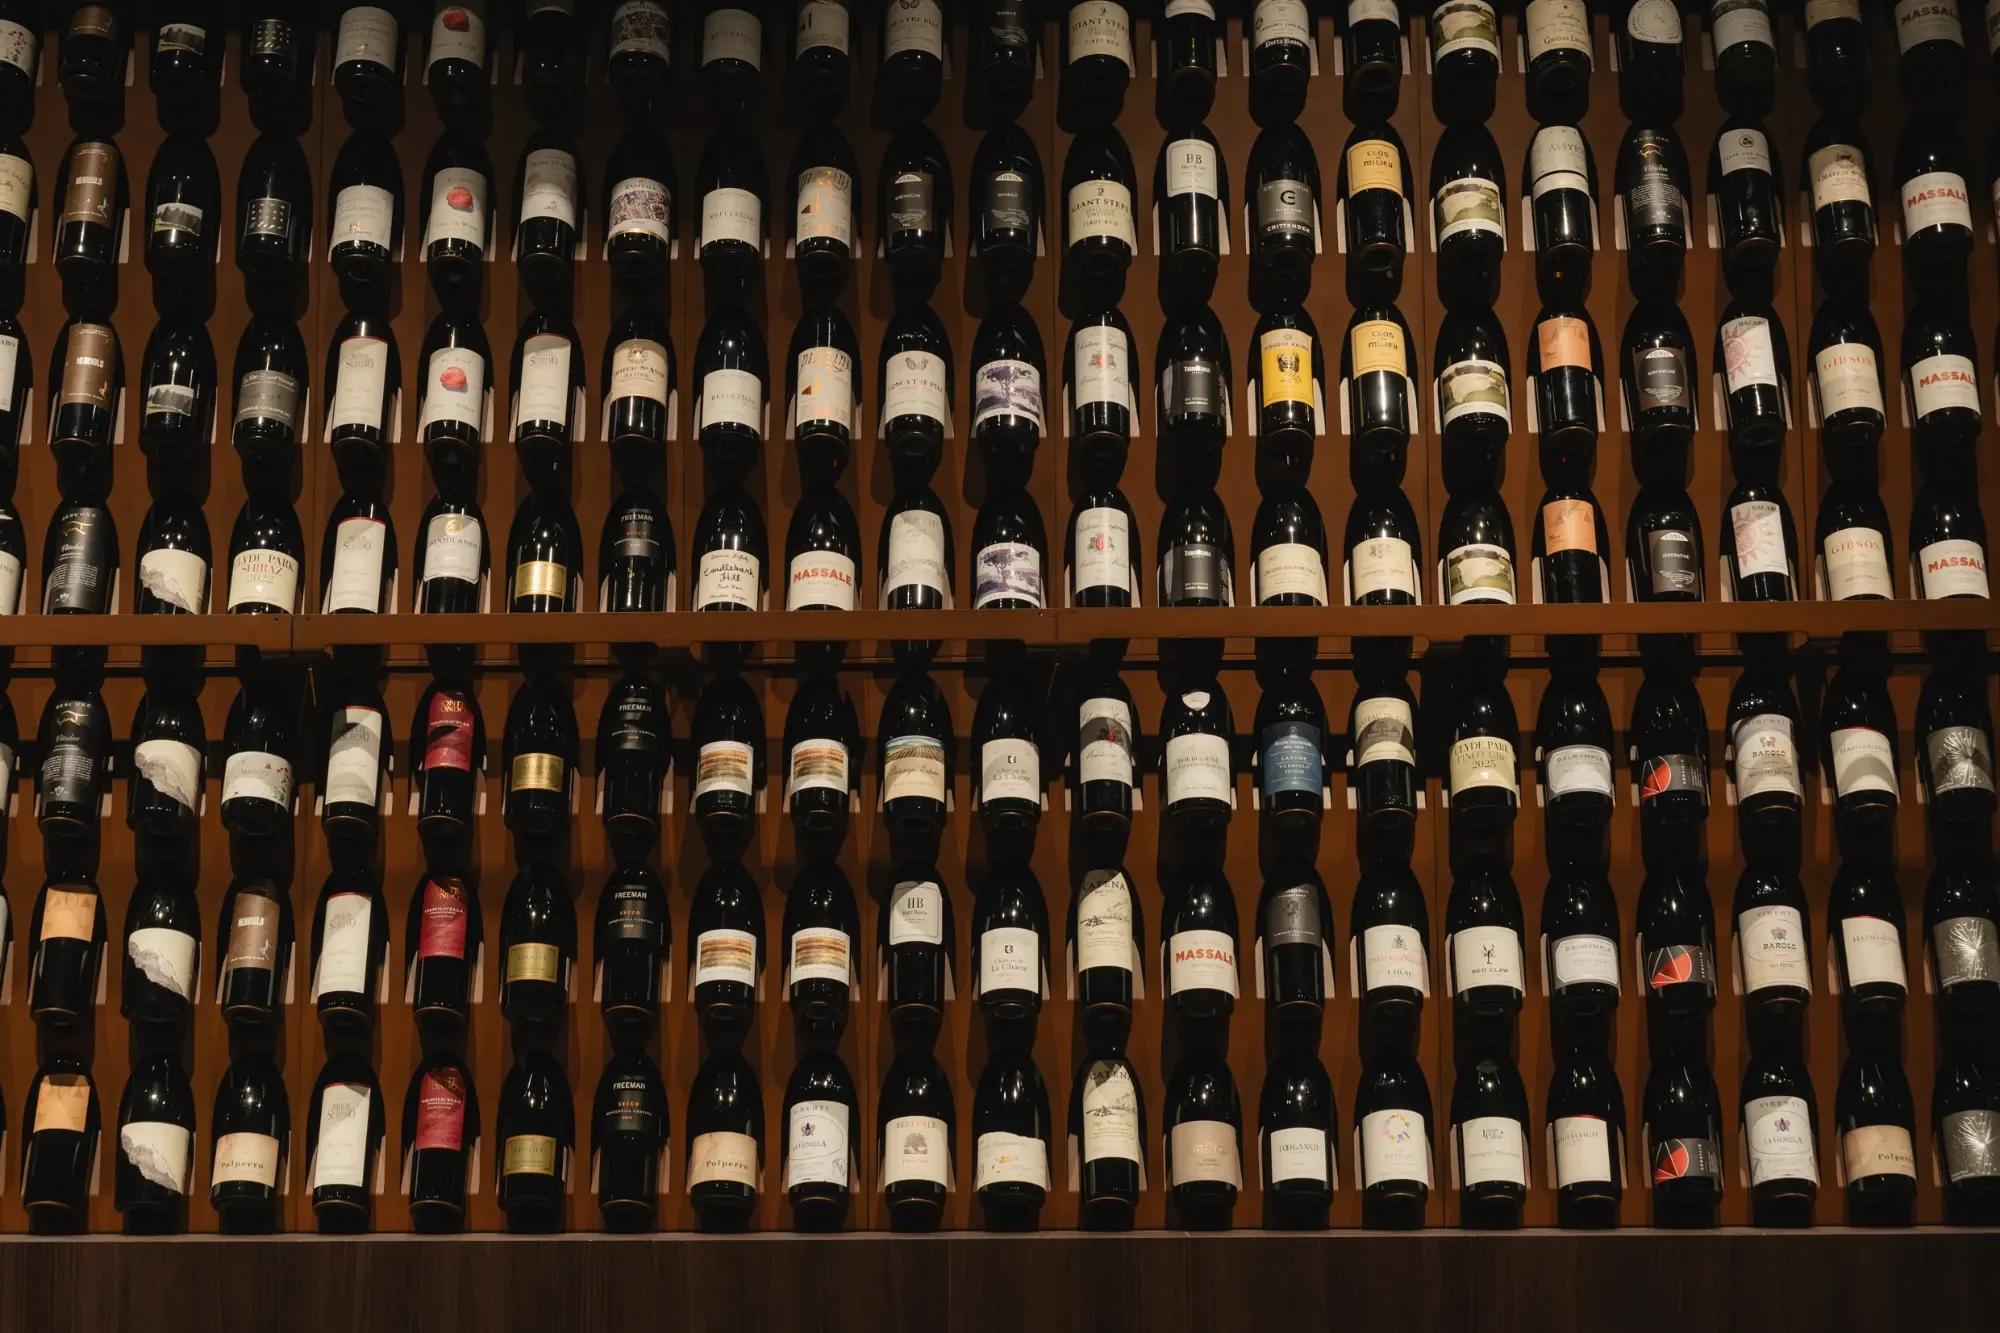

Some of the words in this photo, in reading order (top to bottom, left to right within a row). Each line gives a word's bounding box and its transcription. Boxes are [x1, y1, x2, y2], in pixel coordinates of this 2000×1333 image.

[1901, 6, 1959, 25] MASSAL
[1073, 19, 1101, 31] GIANT
[1072, 199, 1100, 213] GIANT
[1103, 198, 1129, 213] STEPS
[1267, 223, 1310, 233] CRITTENDEN
[1372, 331, 1394, 339] CLOS
[0, 339, 16, 349] ARO
[1824, 354, 1873, 370] GIBSON
[621, 513, 653, 522] FREEMAN
[429, 536, 478, 550] WOODLANDS
[1832, 540, 1881, 555] GIBSON
[268, 554, 295, 573] PARK
[241, 563, 284, 576] SHIRAZ
[704, 564, 755, 578] Candlebark
[720, 573, 741, 583] Hill
[793, 568, 852, 585] MASSALE
[619, 704, 652, 712] FREEMAN
[1454, 741, 1484, 756] CLYDE
[1487, 741, 1509, 754] PARK
[1752, 750, 1785, 758] BAROLO
[1457, 751, 1485, 763] PINOT
[1489, 751, 1508, 761] GRIS
[1472, 760, 1496, 769] 2025
[1083, 880, 1125, 891] CATENA
[615, 891, 647, 899] FREEMAN
[907, 897, 924, 908] HB
[1176, 949, 1234, 966] MASSALE
[1002, 963, 1028, 972] Chaize
[1388, 969, 1414, 977] LIRAC
[613, 1081, 646, 1090] FREEMAN
[1759, 1101, 1800, 1109] VIBERTI
[706, 1160, 749, 1170] Polperro
